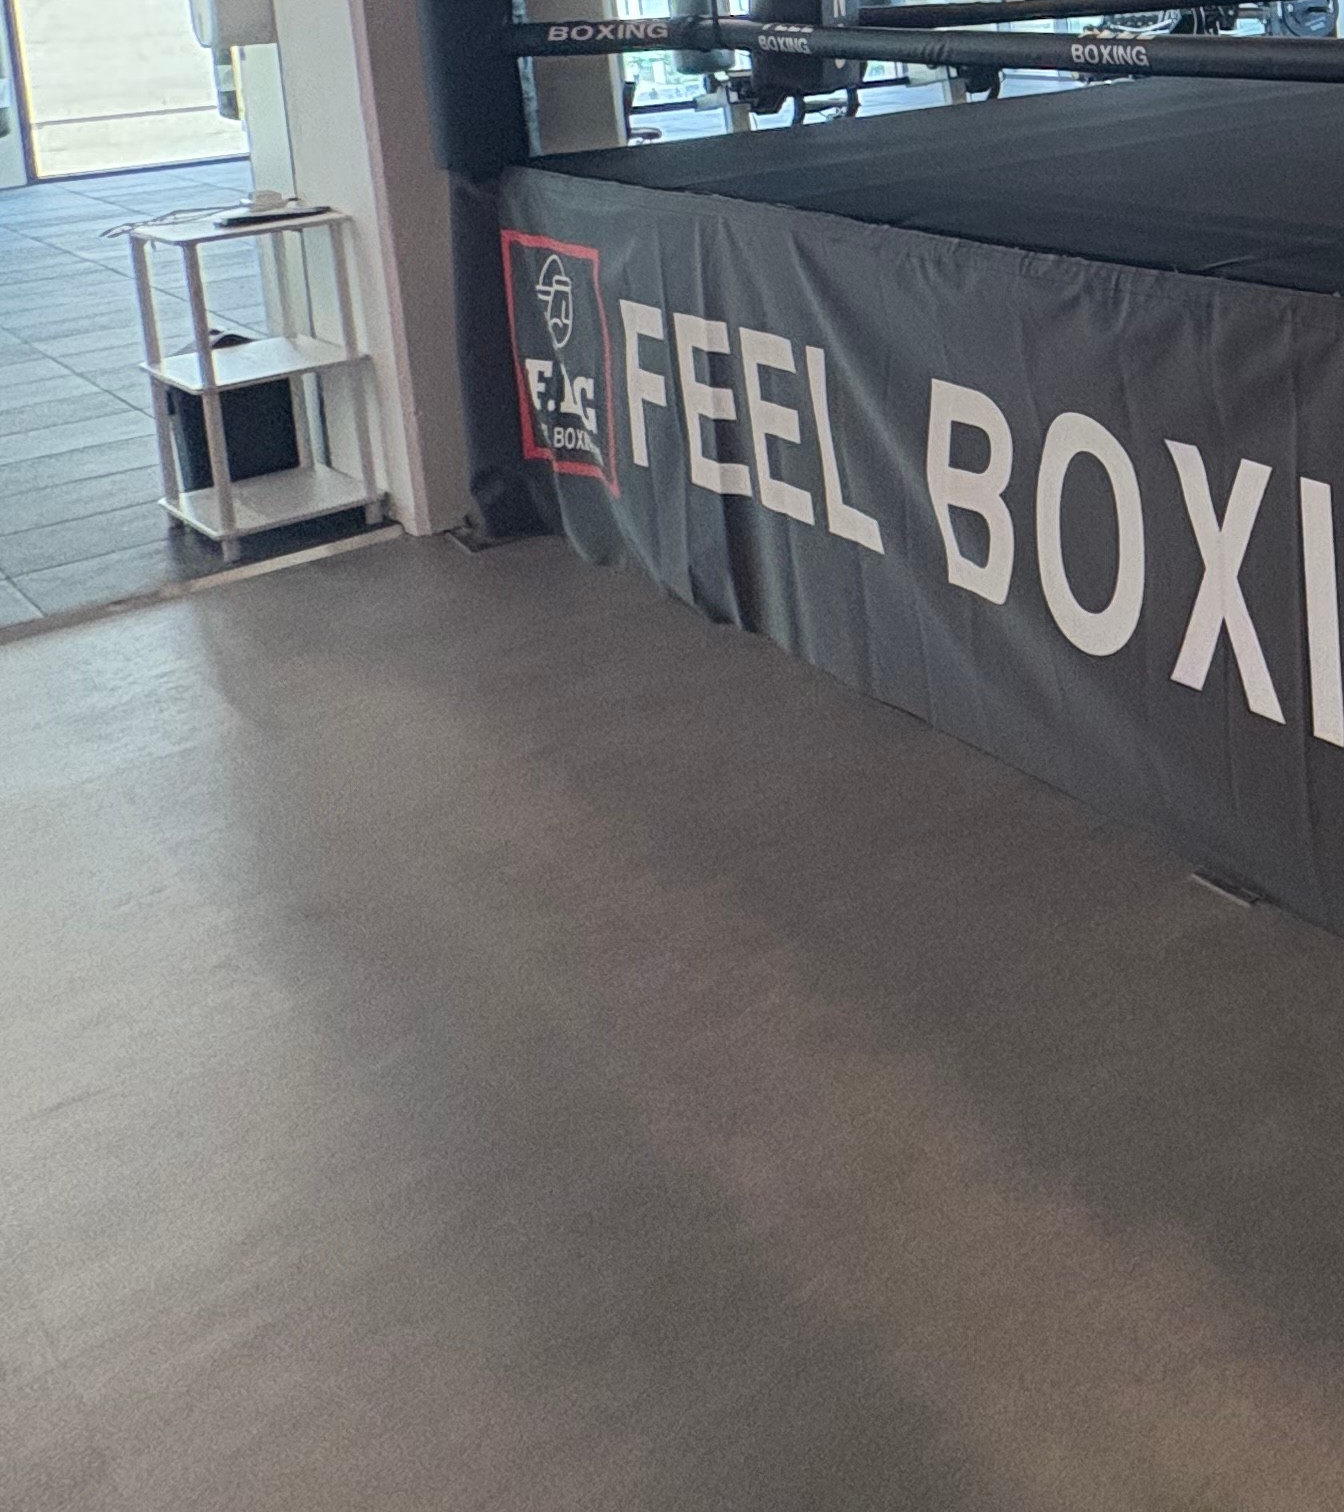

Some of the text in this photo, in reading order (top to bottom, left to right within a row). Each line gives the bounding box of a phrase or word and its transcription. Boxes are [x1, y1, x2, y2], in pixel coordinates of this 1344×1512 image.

[547, 23, 669, 42] BOXING
[757, 35, 812, 55] BOXING
[1070, 43, 1149, 67] BOXING
[619, 299, 885, 555] FEEL
